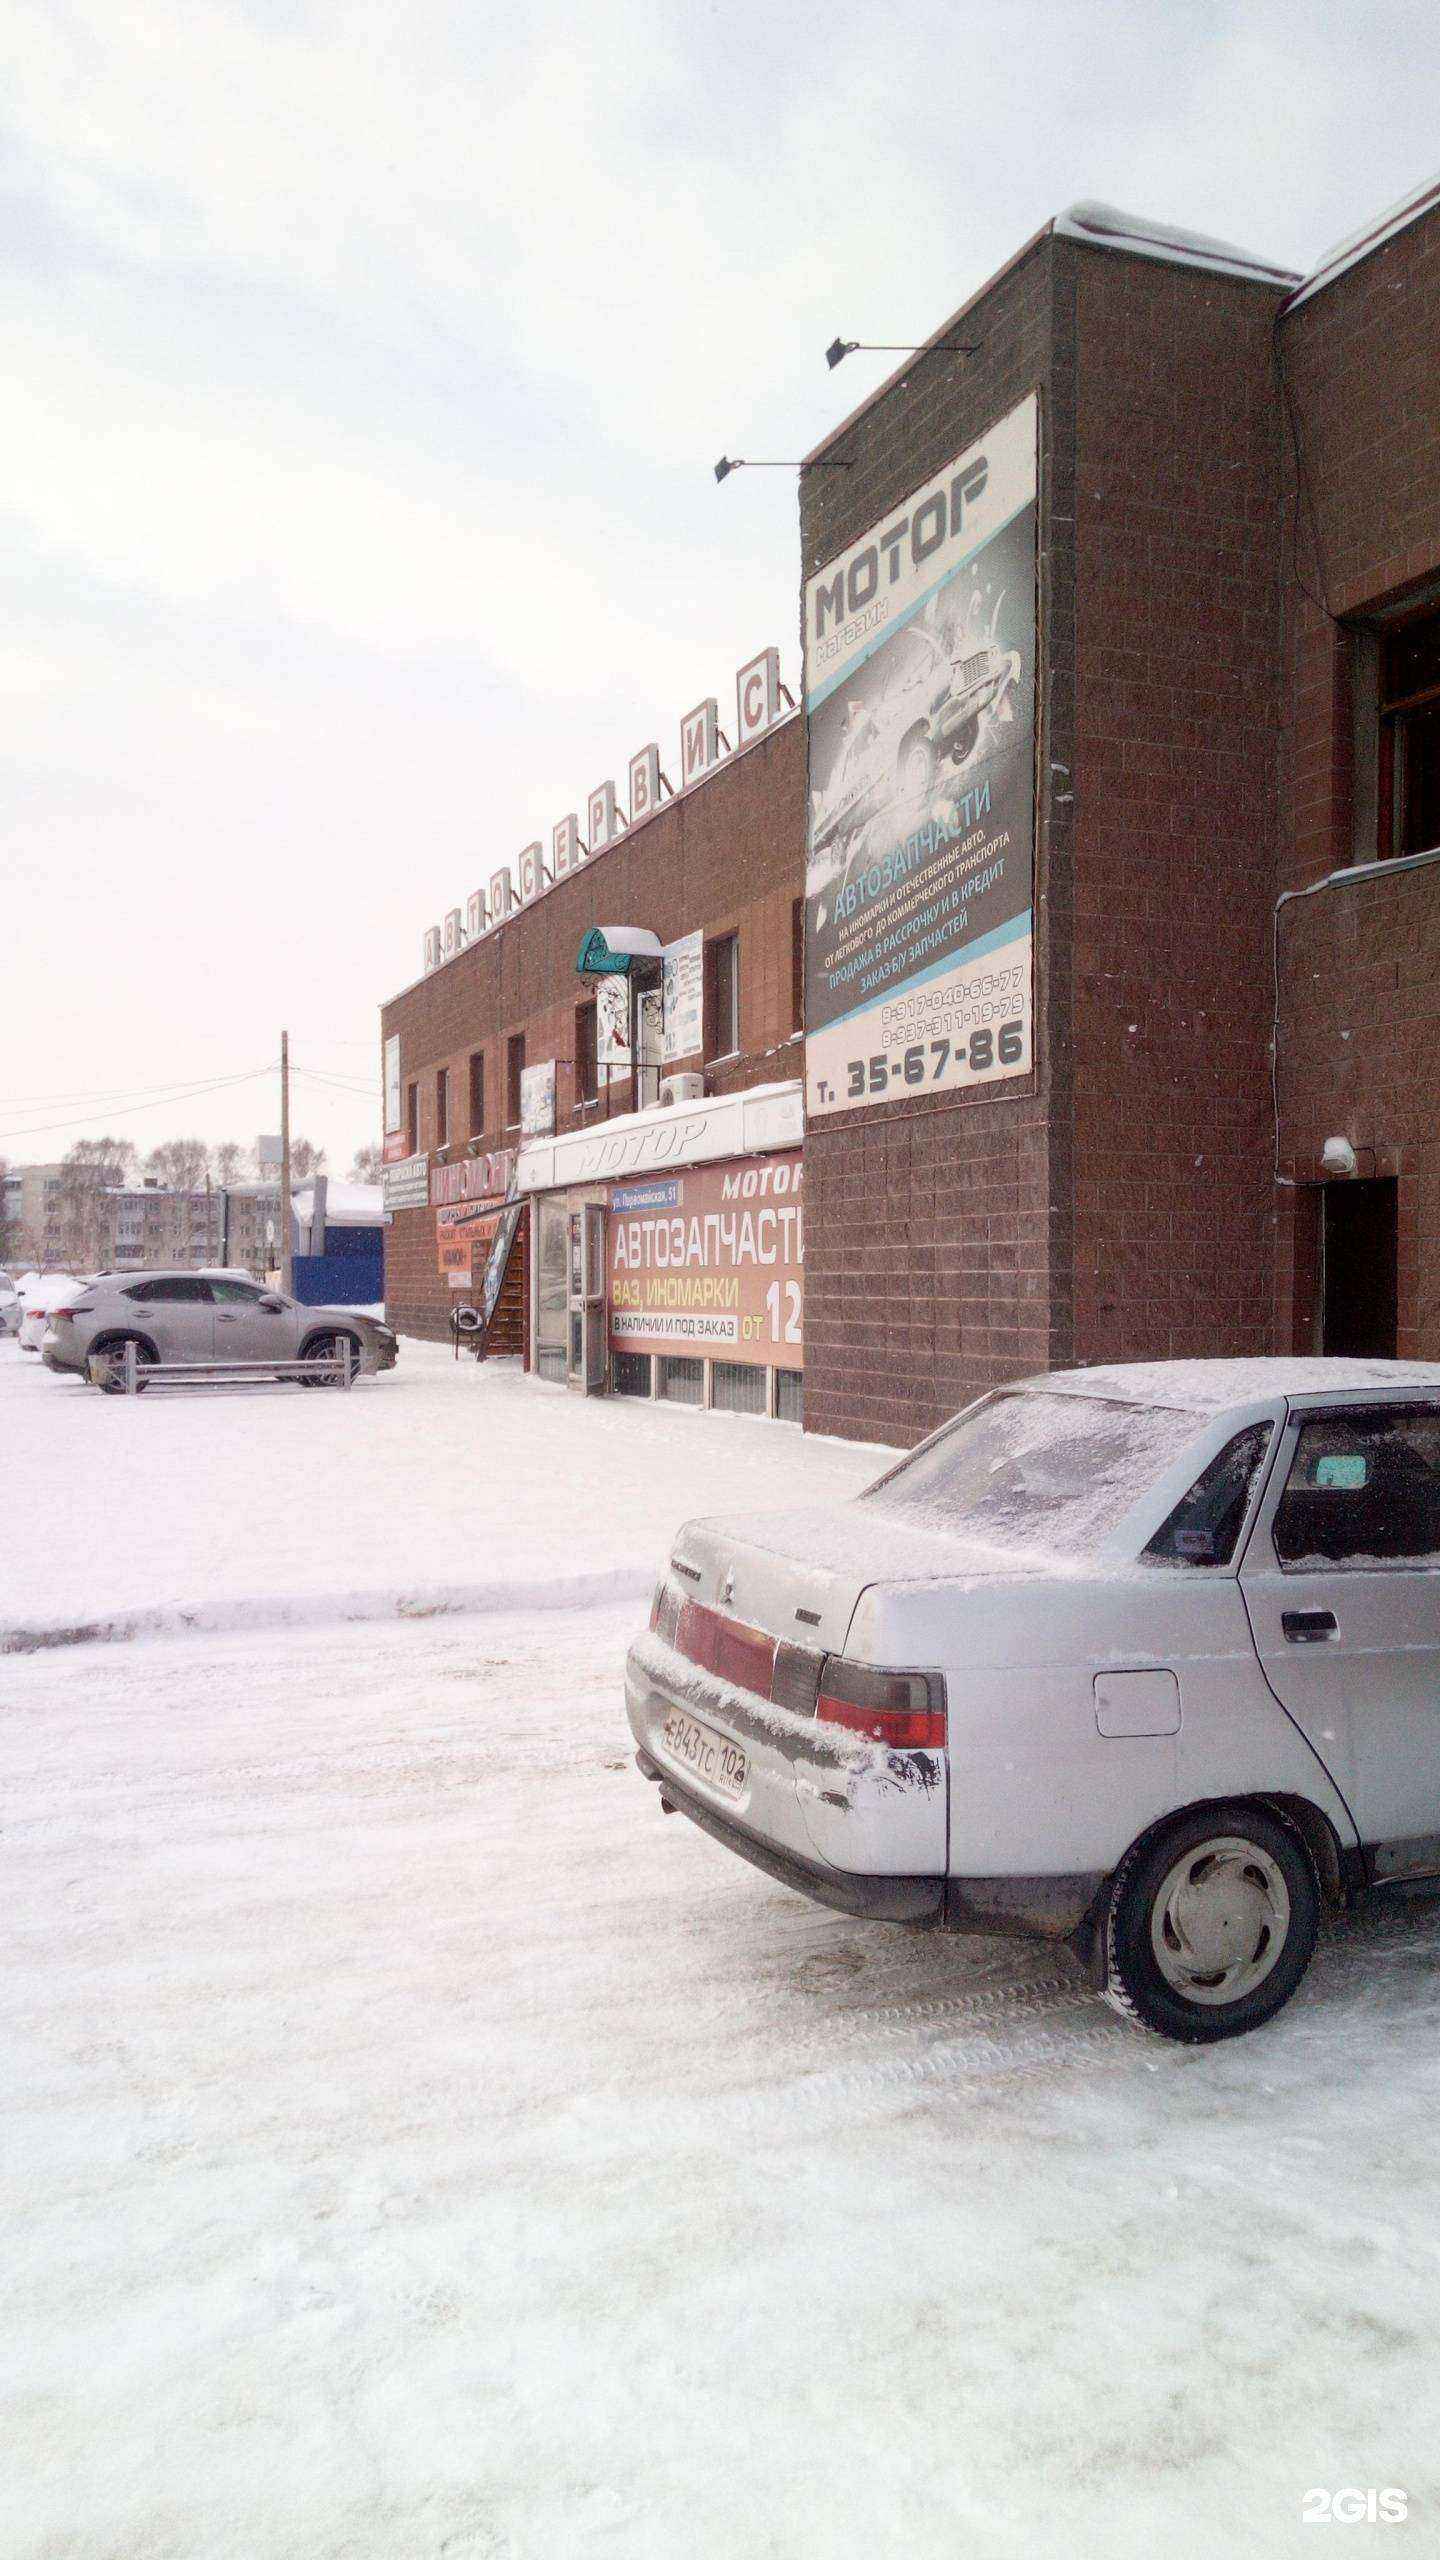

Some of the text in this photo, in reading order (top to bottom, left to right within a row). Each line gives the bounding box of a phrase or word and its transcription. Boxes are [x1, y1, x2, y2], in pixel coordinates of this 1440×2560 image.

[833, 780, 992, 924] АВТОЗАПЧАСТИ
[838, 926, 849, 942] НА
[896, 846, 961, 900] ОТЕЧЕСТВЕННЫЕ
[824, 954, 834, 969] ОТ
[875, 919, 887, 938] ДО
[887, 872, 955, 926] КОММЕРЧЕСКОГО
[954, 831, 1010, 878] ТРАНСПОРТА
[829, 950, 875, 990] ПРОДАЖА
[874, 943, 882, 959] В
[883, 903, 940, 953] РАССРОЧКУ
[951, 890, 960, 908] В
[960, 858, 1006, 902] КРЕДИТ
[860, 966, 892, 995] ЗАКАЗ
[908, 907, 969, 963] ЗАПЧАСТЕЙ
[847, 1019, 1024, 1098] 35-67-86
[577, 1119, 708, 1174] МОТОР
[614, 1316, 735, 1337] В НАЛИЧИИ И ПОД ЗАКАЗ
[647, 1277, 740, 1308] ИНОМАРКИ
